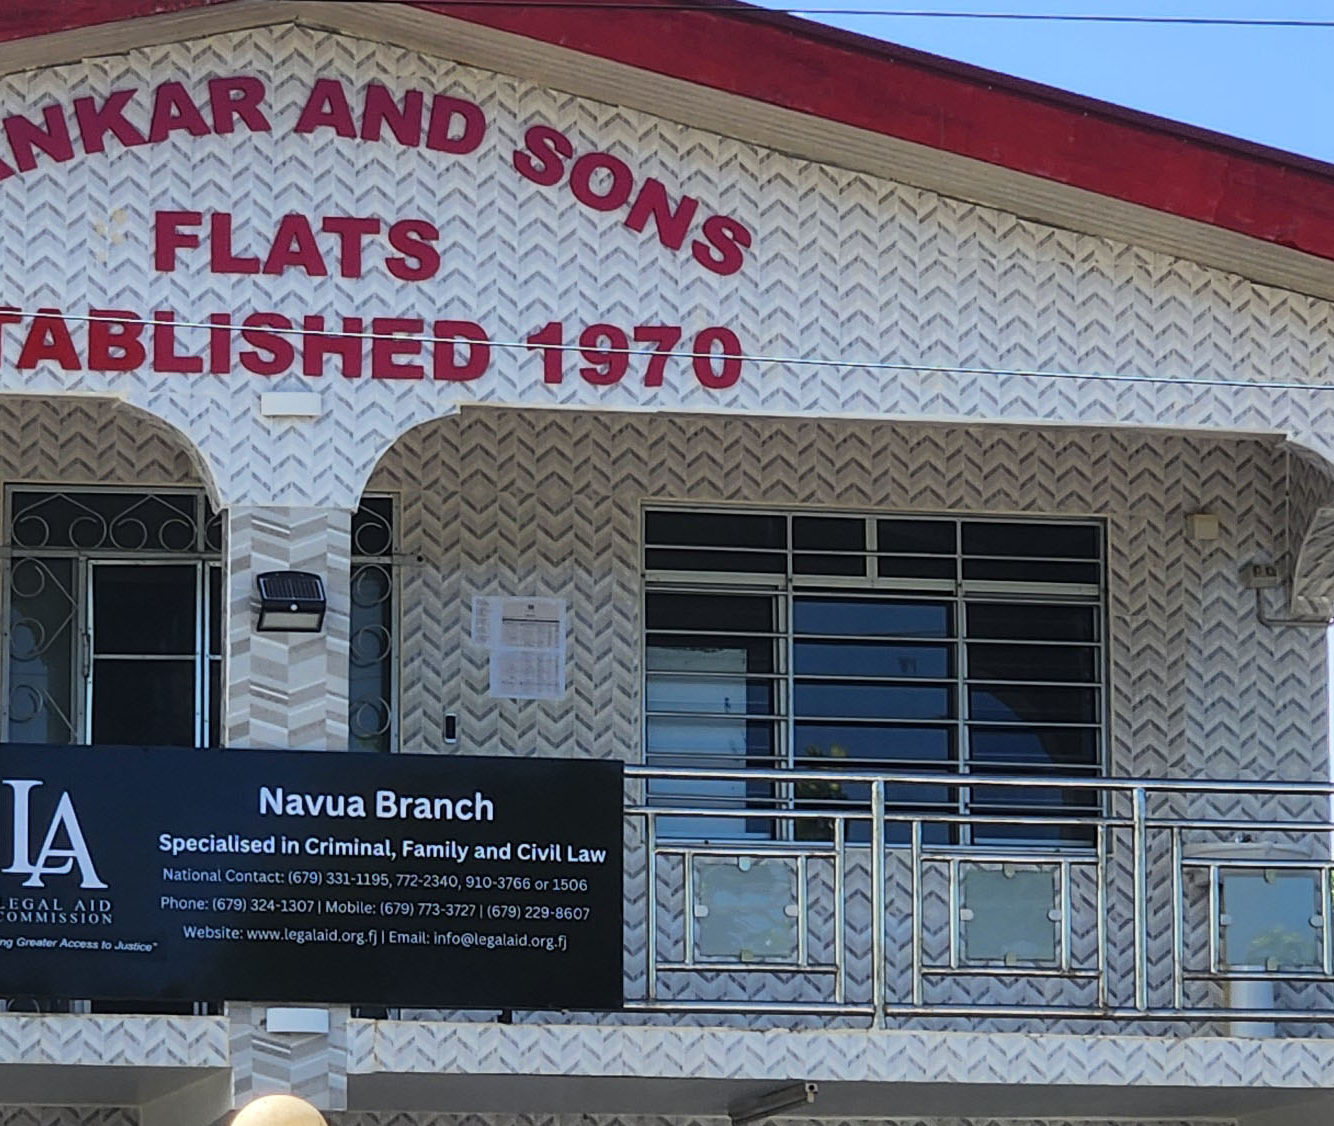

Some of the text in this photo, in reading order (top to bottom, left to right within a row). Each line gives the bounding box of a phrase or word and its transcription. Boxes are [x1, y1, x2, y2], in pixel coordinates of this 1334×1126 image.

[294, 78, 487, 155] AND
[513, 125, 752, 276] SONS
[154, 210, 441, 281] FLATS
[527, 321, 742, 389] 1970
[259, 786, 494, 821] Navua Branch
[159, 833, 607, 863] Specialised in Criminal, Family and Civil Law
[162, 868, 588, 892] National Contact: (679) 331-1195, 772-2340, 910-3766 or 1506
[74, 899, 112, 912] AID
[160, 896, 209, 911] Phone:
[212, 898, 247, 914] (679)
[250, 898, 314, 913] 324-1307
[325, 899, 376, 915] Mobile:
[380, 901, 414, 917] (679)
[418, 902, 476, 918] 773-3727
[487, 904, 521, 919] (679)
[524, 906, 591, 921] 229-8607
[17, 937, 57, 948] Greater
[59, 938, 98, 949] Access
[101, 940, 112, 949] to
[183, 925, 244, 940] Website:
[246, 926, 377, 946] www.legalaid.org.fj
[389, 930, 430, 945] Email:
[433, 931, 568, 951] info@legalaid.org.fj
